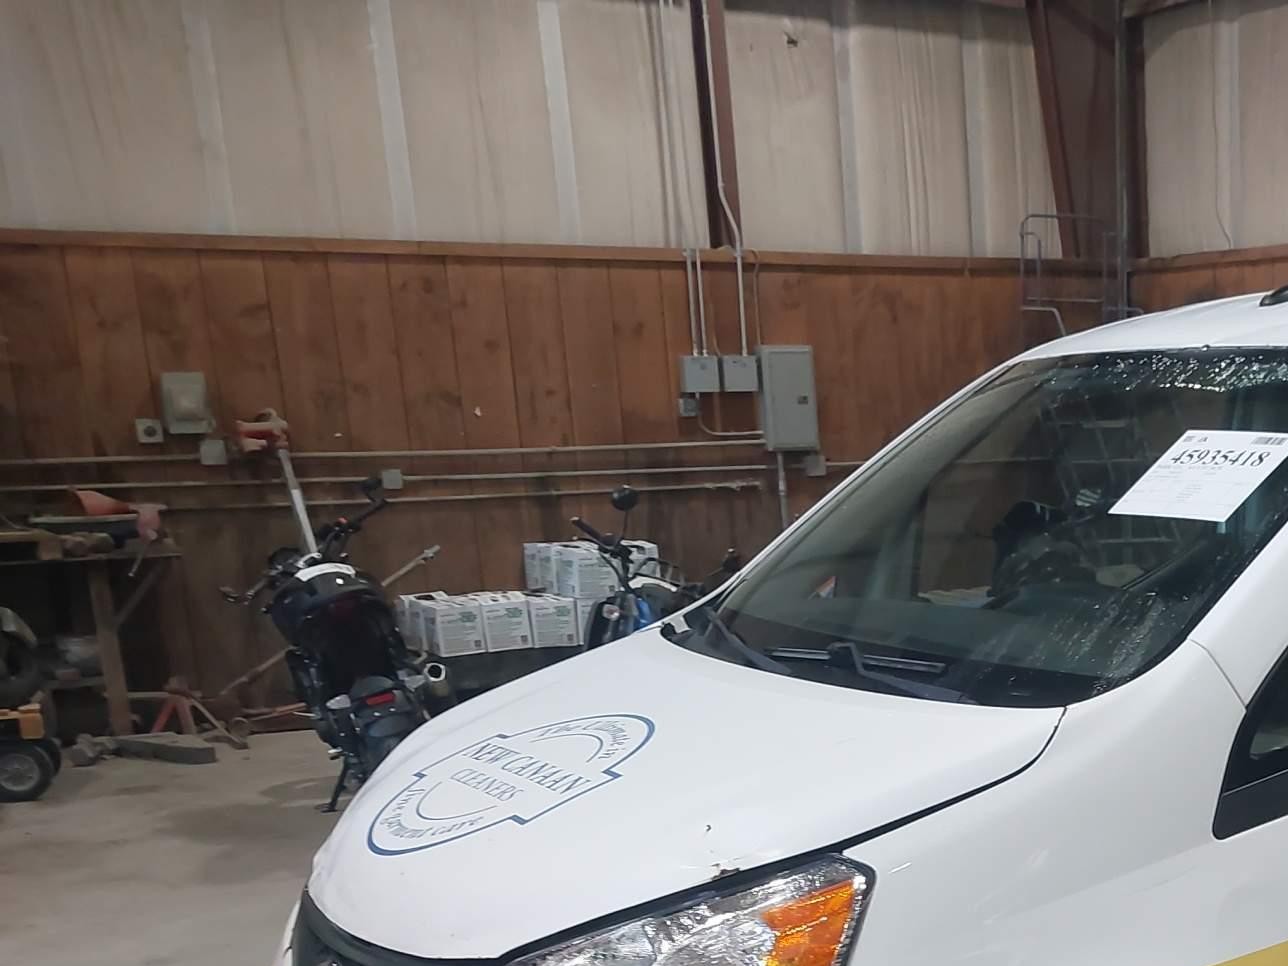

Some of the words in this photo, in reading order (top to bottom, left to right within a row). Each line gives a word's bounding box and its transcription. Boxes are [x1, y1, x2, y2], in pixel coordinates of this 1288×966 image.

[1171, 449, 1272, 468] 45935418
[449, 768, 524, 802] CLEANERS
[462, 742, 521, 765] NEW
[500, 756, 592, 795] CANAAN
